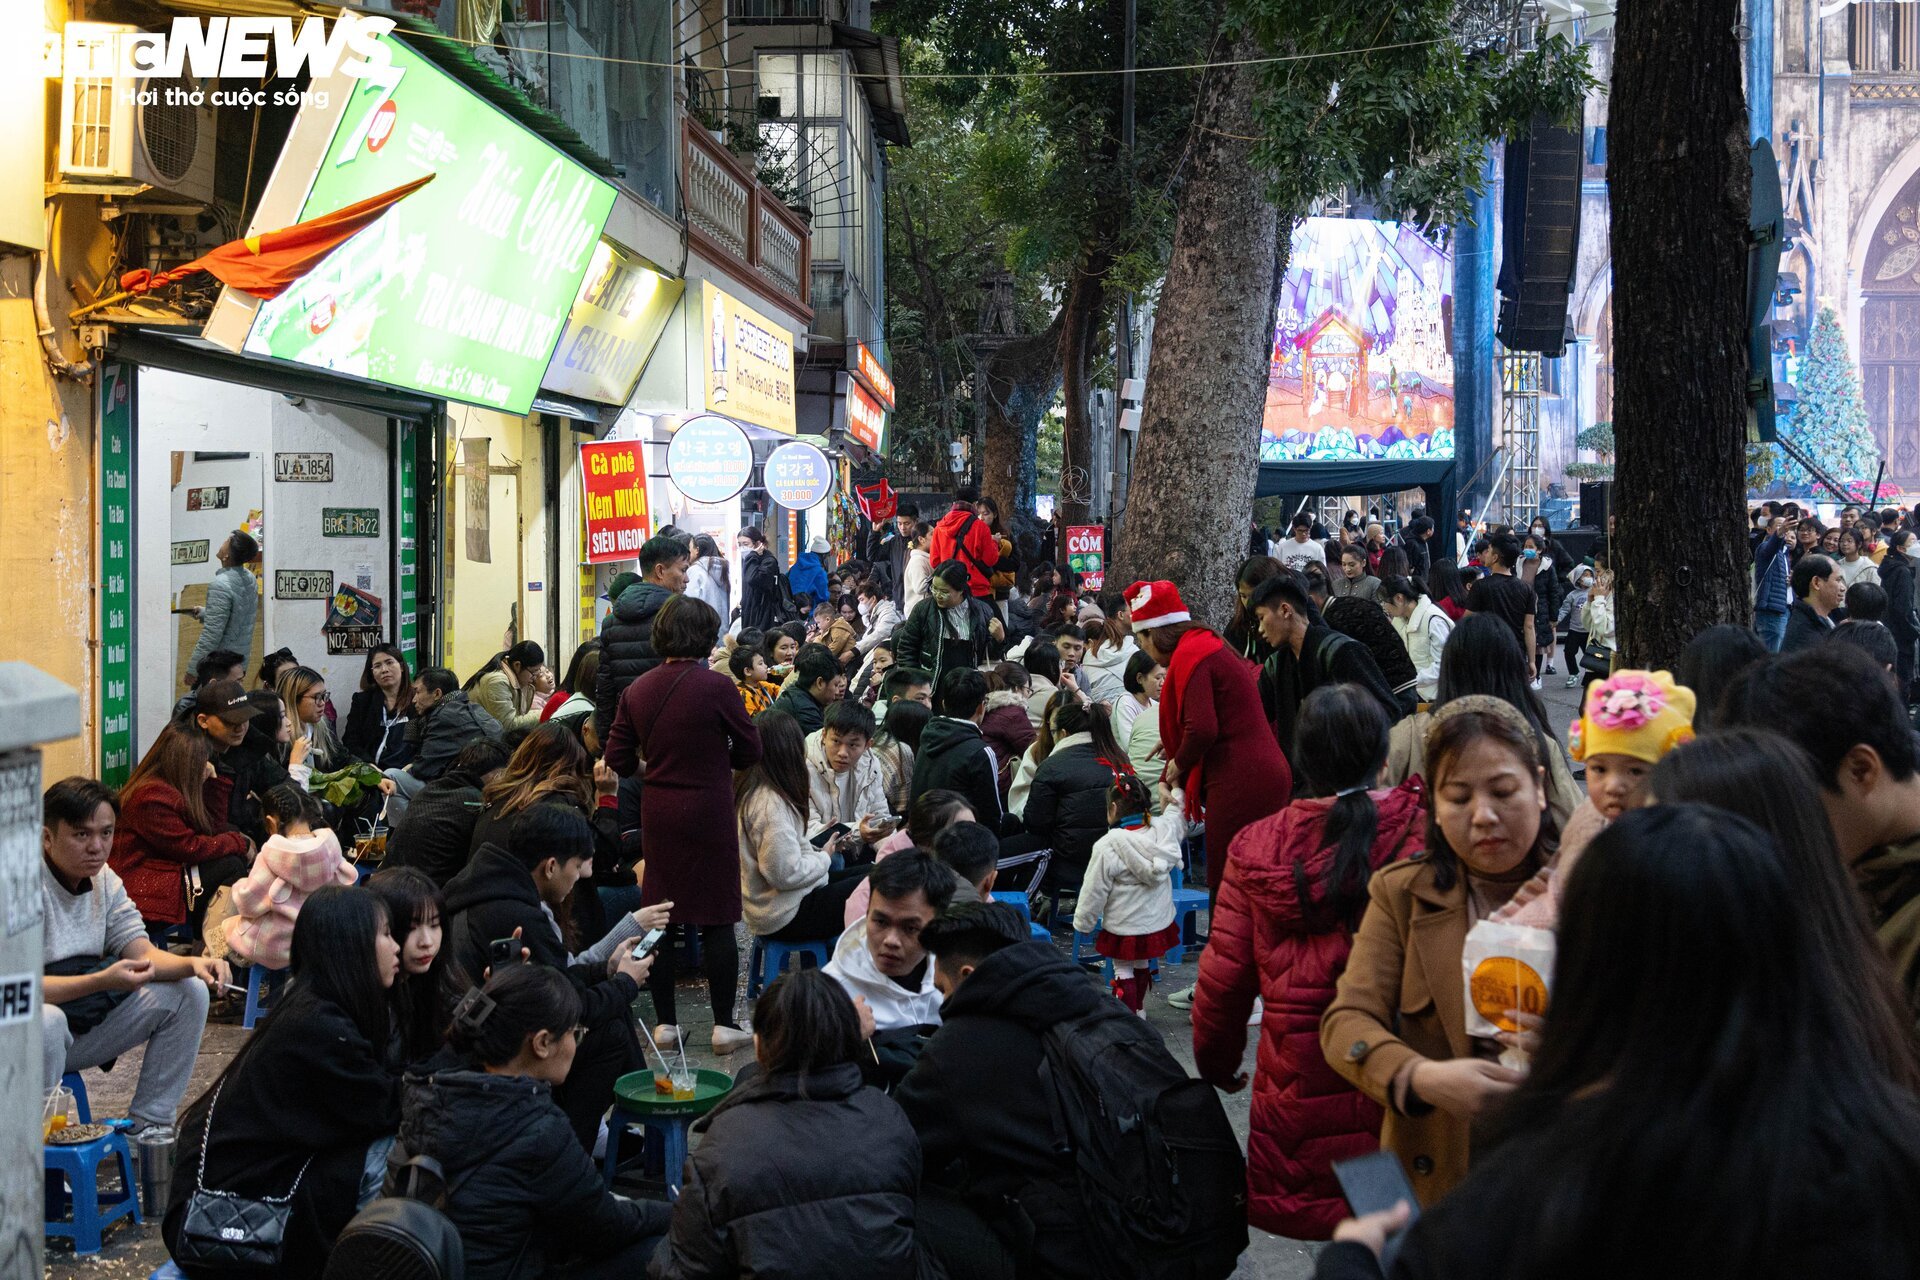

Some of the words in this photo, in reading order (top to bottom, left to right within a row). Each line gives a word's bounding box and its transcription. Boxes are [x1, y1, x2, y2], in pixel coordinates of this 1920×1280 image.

[517, 158, 596, 284] Coffee
[448, 284, 508, 347] CHANH
[771, 334, 789, 372] FOOD
[460, 370, 473, 393] 2
[277, 460, 289, 475] LV
[307, 459, 330, 475] 1854
[590, 452, 609, 475] Cà
[611, 451, 635, 476] phê
[588, 491, 613, 520] Kem
[614, 477, 646, 518] MUỐI
[781, 489, 813, 501] 30.000
[324, 518, 343, 533] BRA
[355, 518, 378, 533] 1822
[592, 528, 615, 555] SIÊU
[617, 528, 646, 551] NGON
[1068, 529, 1102, 553] CỐM
[277, 577, 297, 592] CHE
[308, 577, 331, 593] 1928
[1085, 573, 1102, 588] CỐM
[0, 980, 31, 1019] AS
[1511, 984, 1539, 1014] 10
